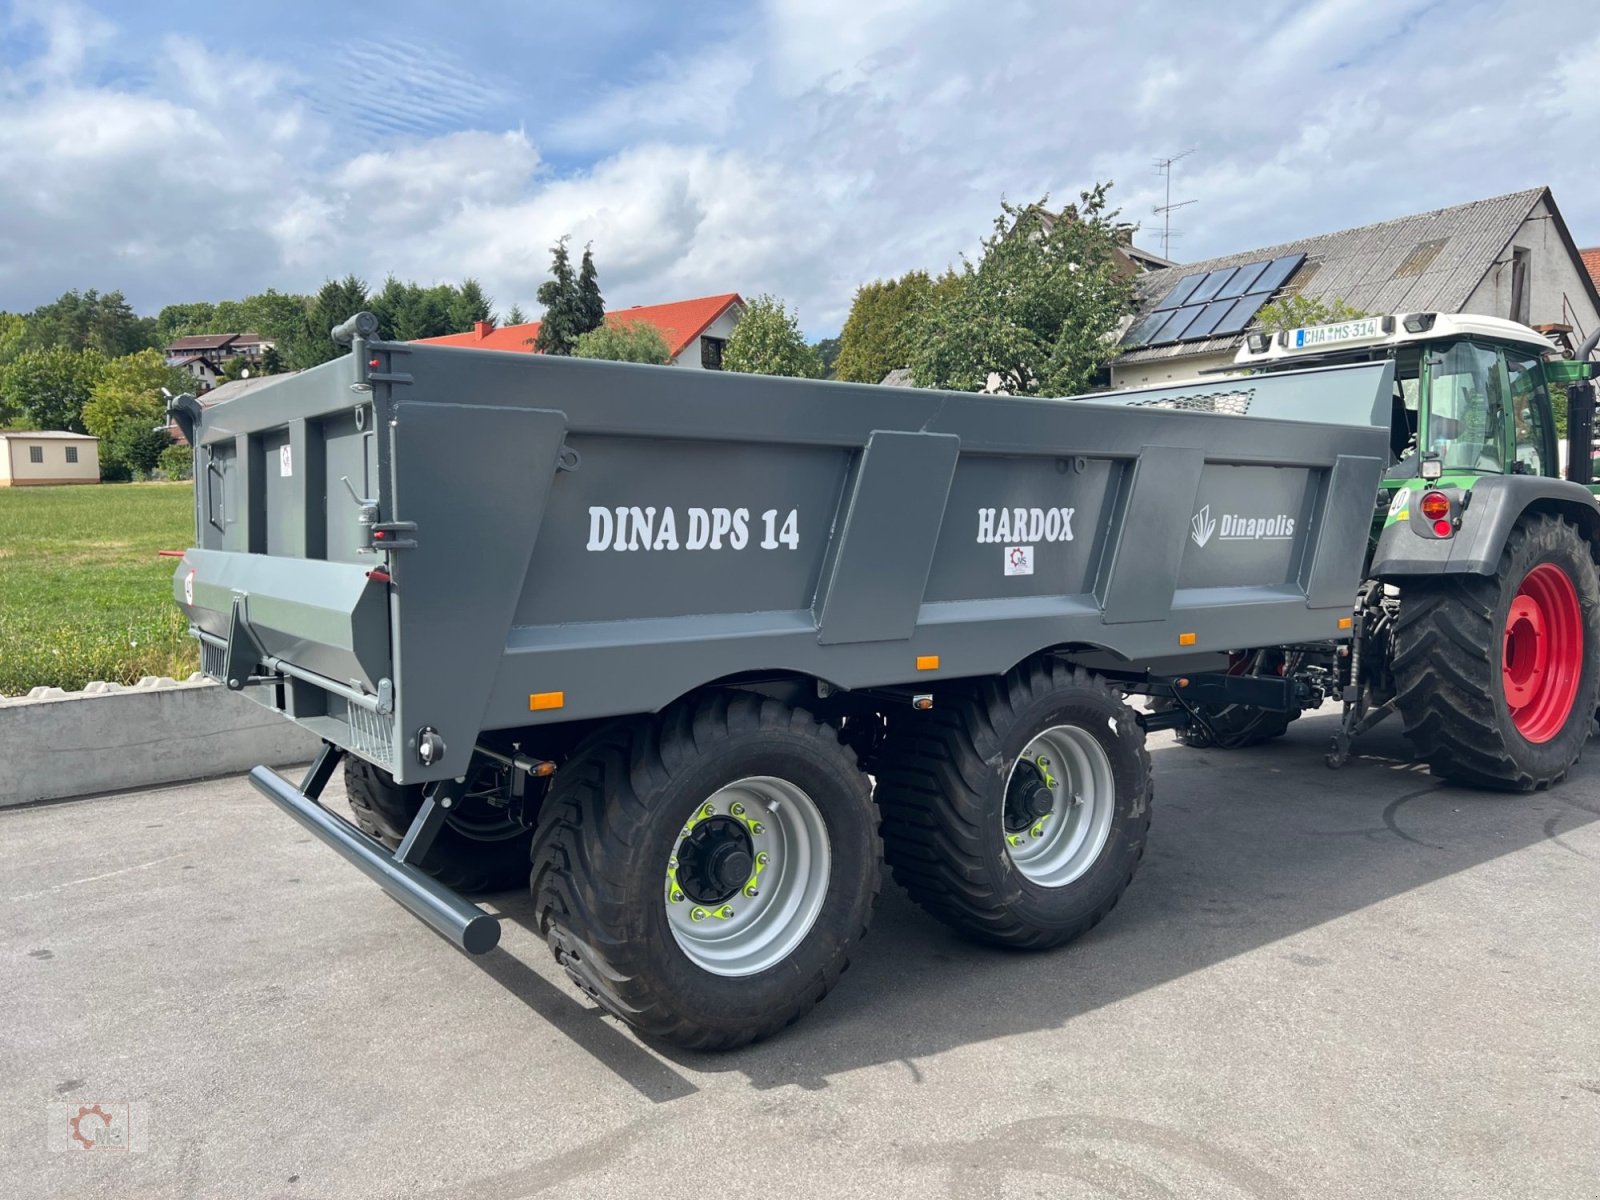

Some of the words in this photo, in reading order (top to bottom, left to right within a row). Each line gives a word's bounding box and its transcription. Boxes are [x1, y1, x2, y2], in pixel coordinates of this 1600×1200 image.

[1304, 329, 1325, 344] CHA
[586, 506, 680, 551] DINA
[685, 507, 750, 550] DPS
[760, 509, 799, 550] 14
[976, 507, 1075, 543] HARDOX
[1220, 514, 1295, 540] Dinapolis
